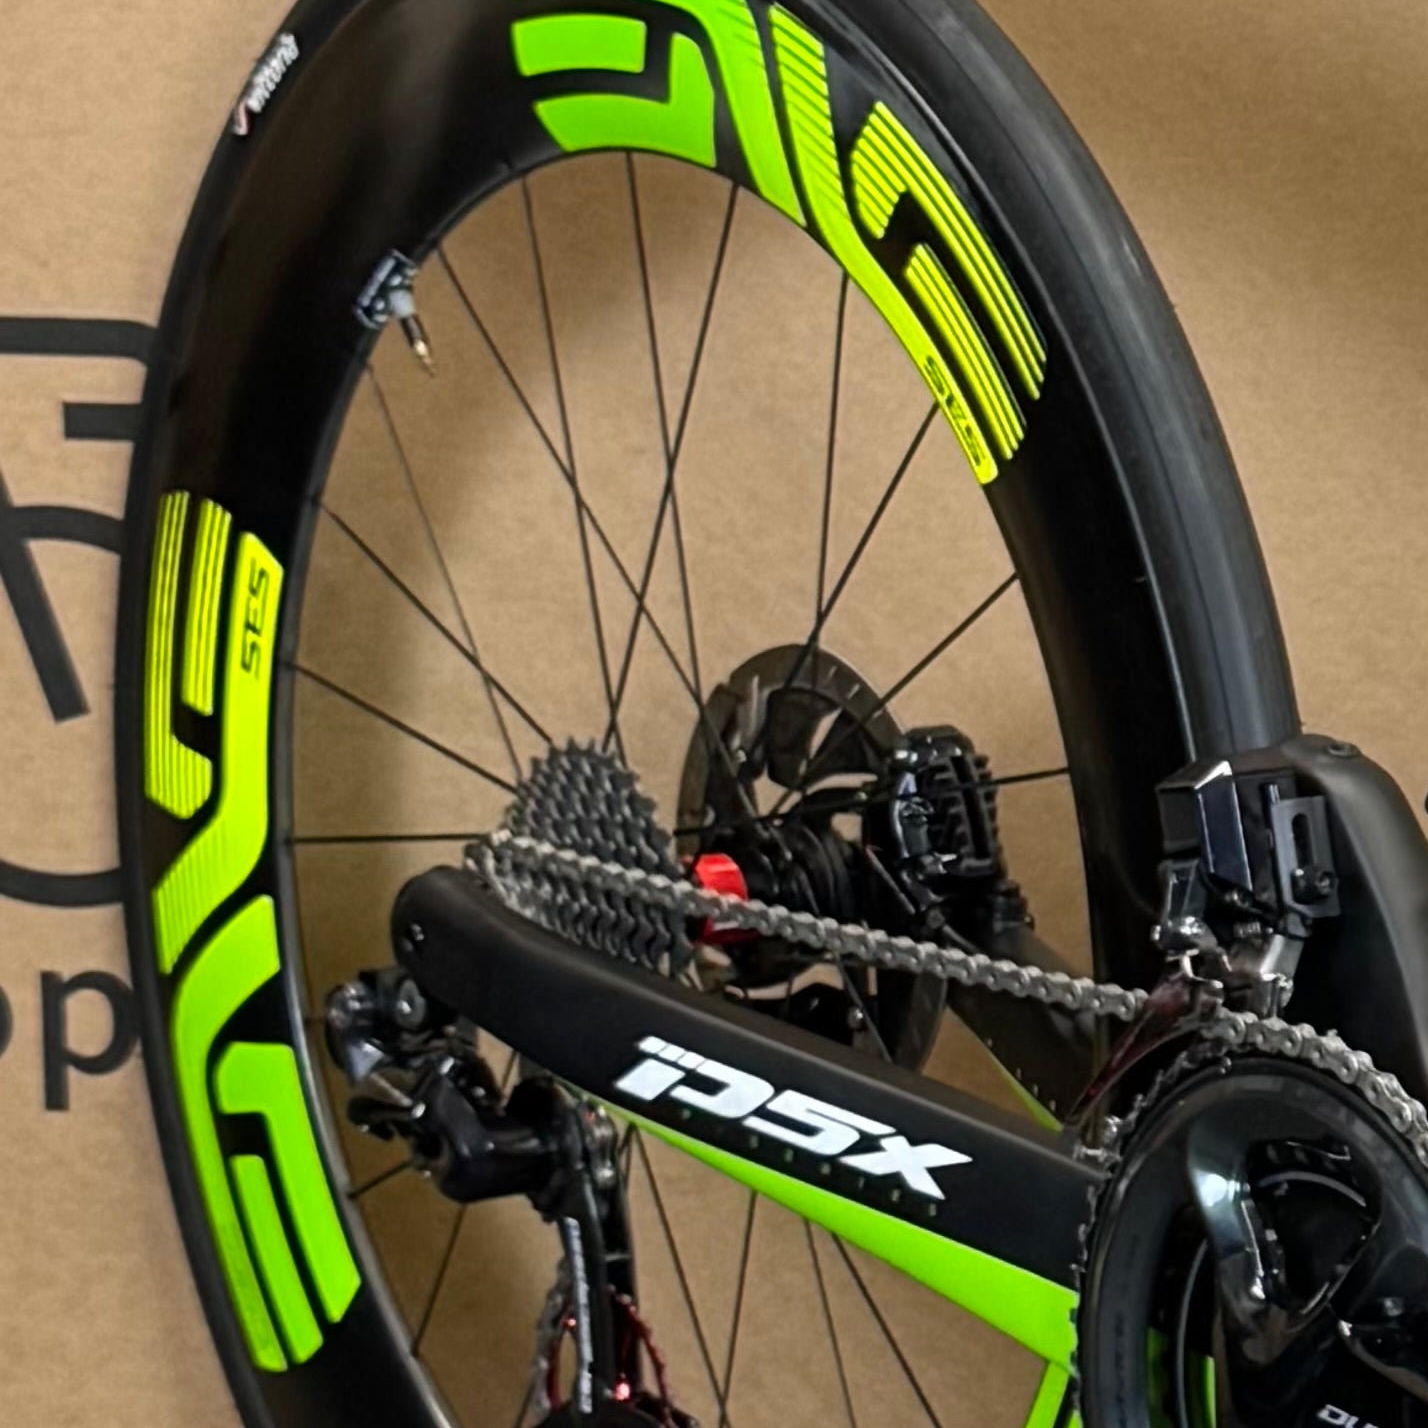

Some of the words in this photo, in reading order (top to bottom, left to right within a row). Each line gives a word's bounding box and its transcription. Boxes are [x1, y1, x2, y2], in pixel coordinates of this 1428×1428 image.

[924, 353, 982, 468] SES
[241, 555, 270, 682] SES
[614, 1035, 974, 1201] P5X
